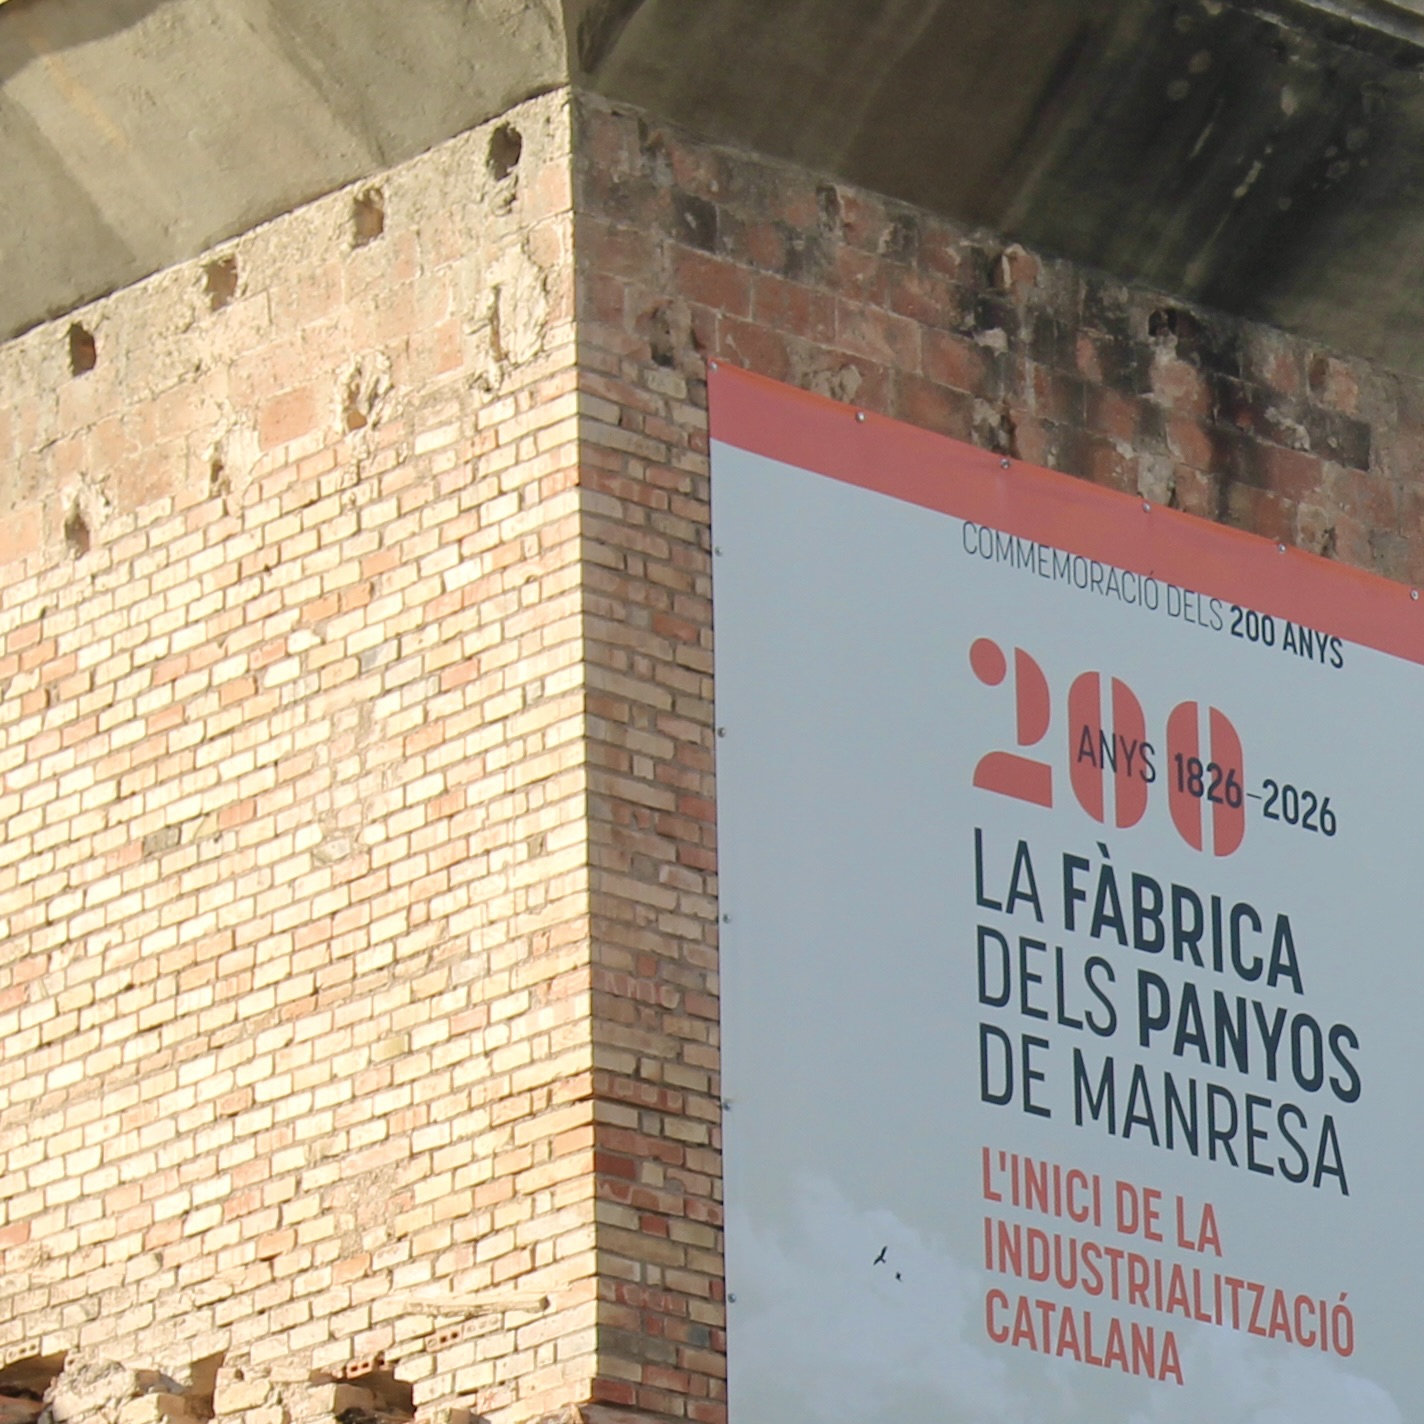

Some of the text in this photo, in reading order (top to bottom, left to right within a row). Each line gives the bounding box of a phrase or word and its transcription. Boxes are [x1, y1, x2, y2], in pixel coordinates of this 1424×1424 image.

[962, 521, 1344, 668] COMMEMORACIÓ DELS 200 ANYS
[1077, 724, 1157, 784] ANYS
[974, 827, 1304, 996] LA FÀBRICA
[977, 924, 1362, 1103] DELS PANYOS
[979, 1022, 1350, 1197] DE MANRESA
[982, 1146, 1223, 1258] L'INICI DE LA
[984, 1217, 1355, 1358] INDUSTRIALITZACIÓ
[985, 1288, 1184, 1386] CATALANA
